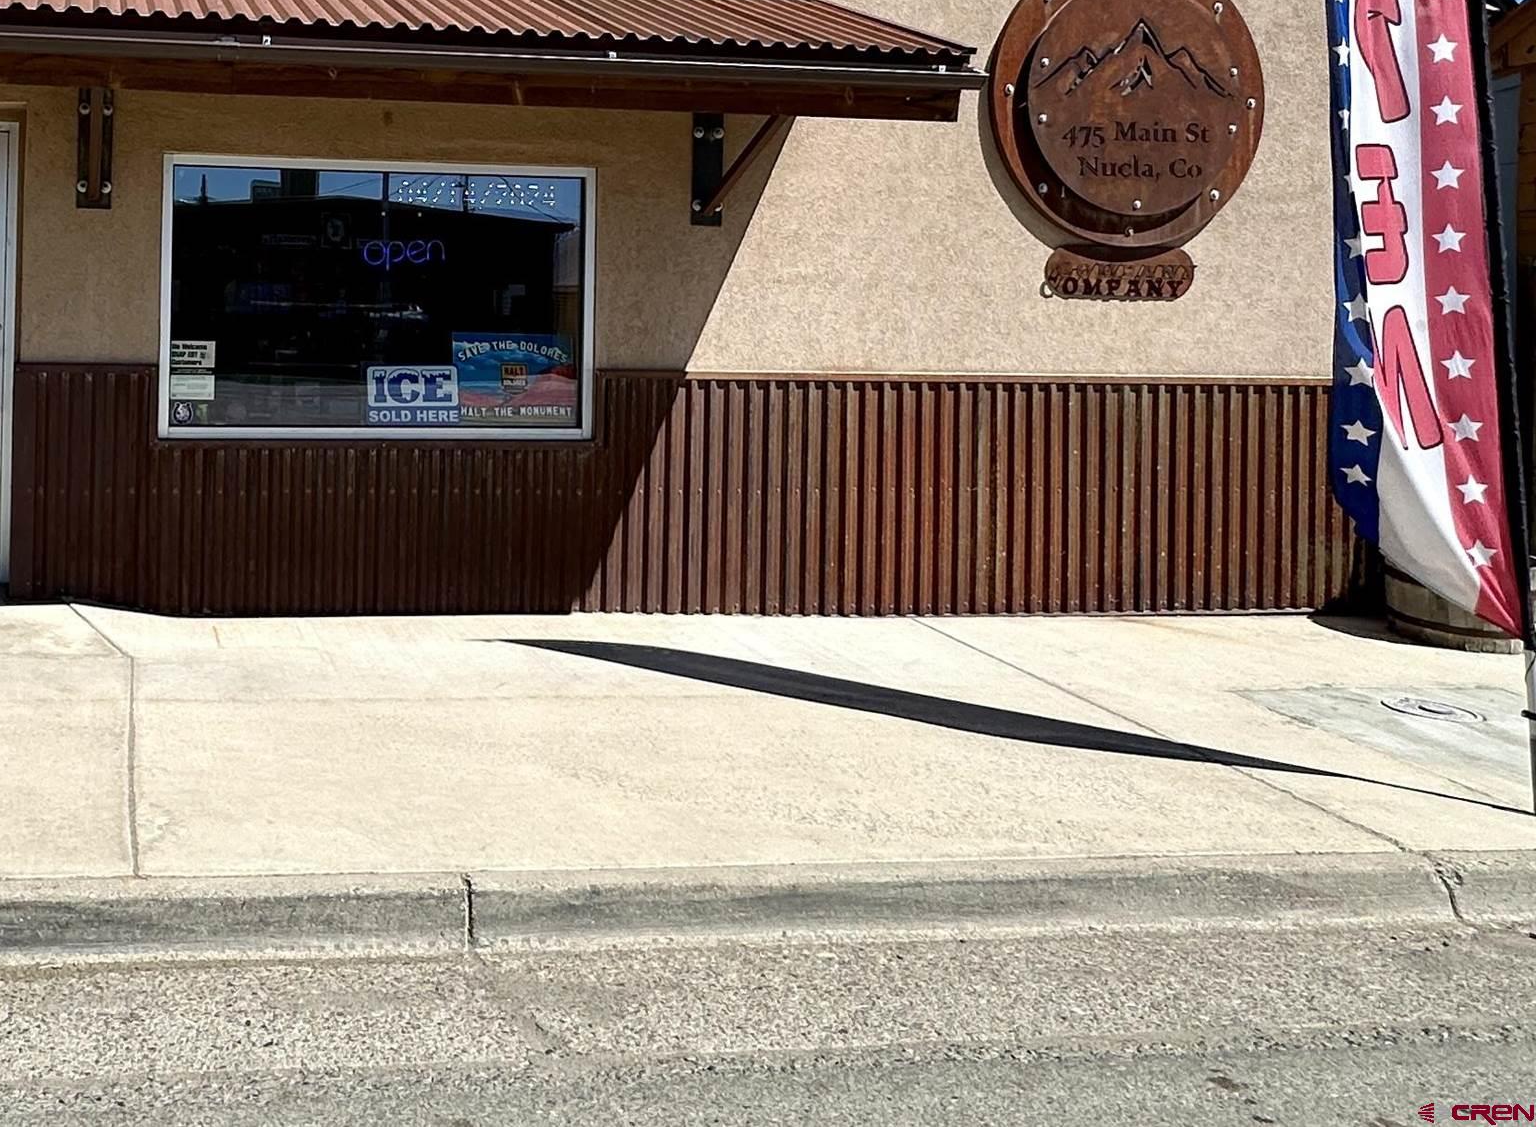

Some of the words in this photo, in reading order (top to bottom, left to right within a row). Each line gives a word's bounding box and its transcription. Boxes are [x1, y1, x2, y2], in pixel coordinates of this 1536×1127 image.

[1062, 125, 1105, 148] 475
[1113, 121, 1177, 143] Main
[1184, 122, 1211, 144] St
[1076, 153, 1161, 183] Nucla,
[1168, 157, 1203, 179] Co
[363, 239, 446, 271] open
[457, 345, 486, 362] SAVE
[491, 340, 514, 351] THE
[519, 341, 569, 363] DOLORES
[372, 367, 453, 404] ICE
[368, 410, 412, 422] SOLD
[416, 410, 459, 422] HERE
[460, 407, 487, 417] HALT
[494, 406, 514, 417] THE
[519, 406, 573, 417] MONUMENT
